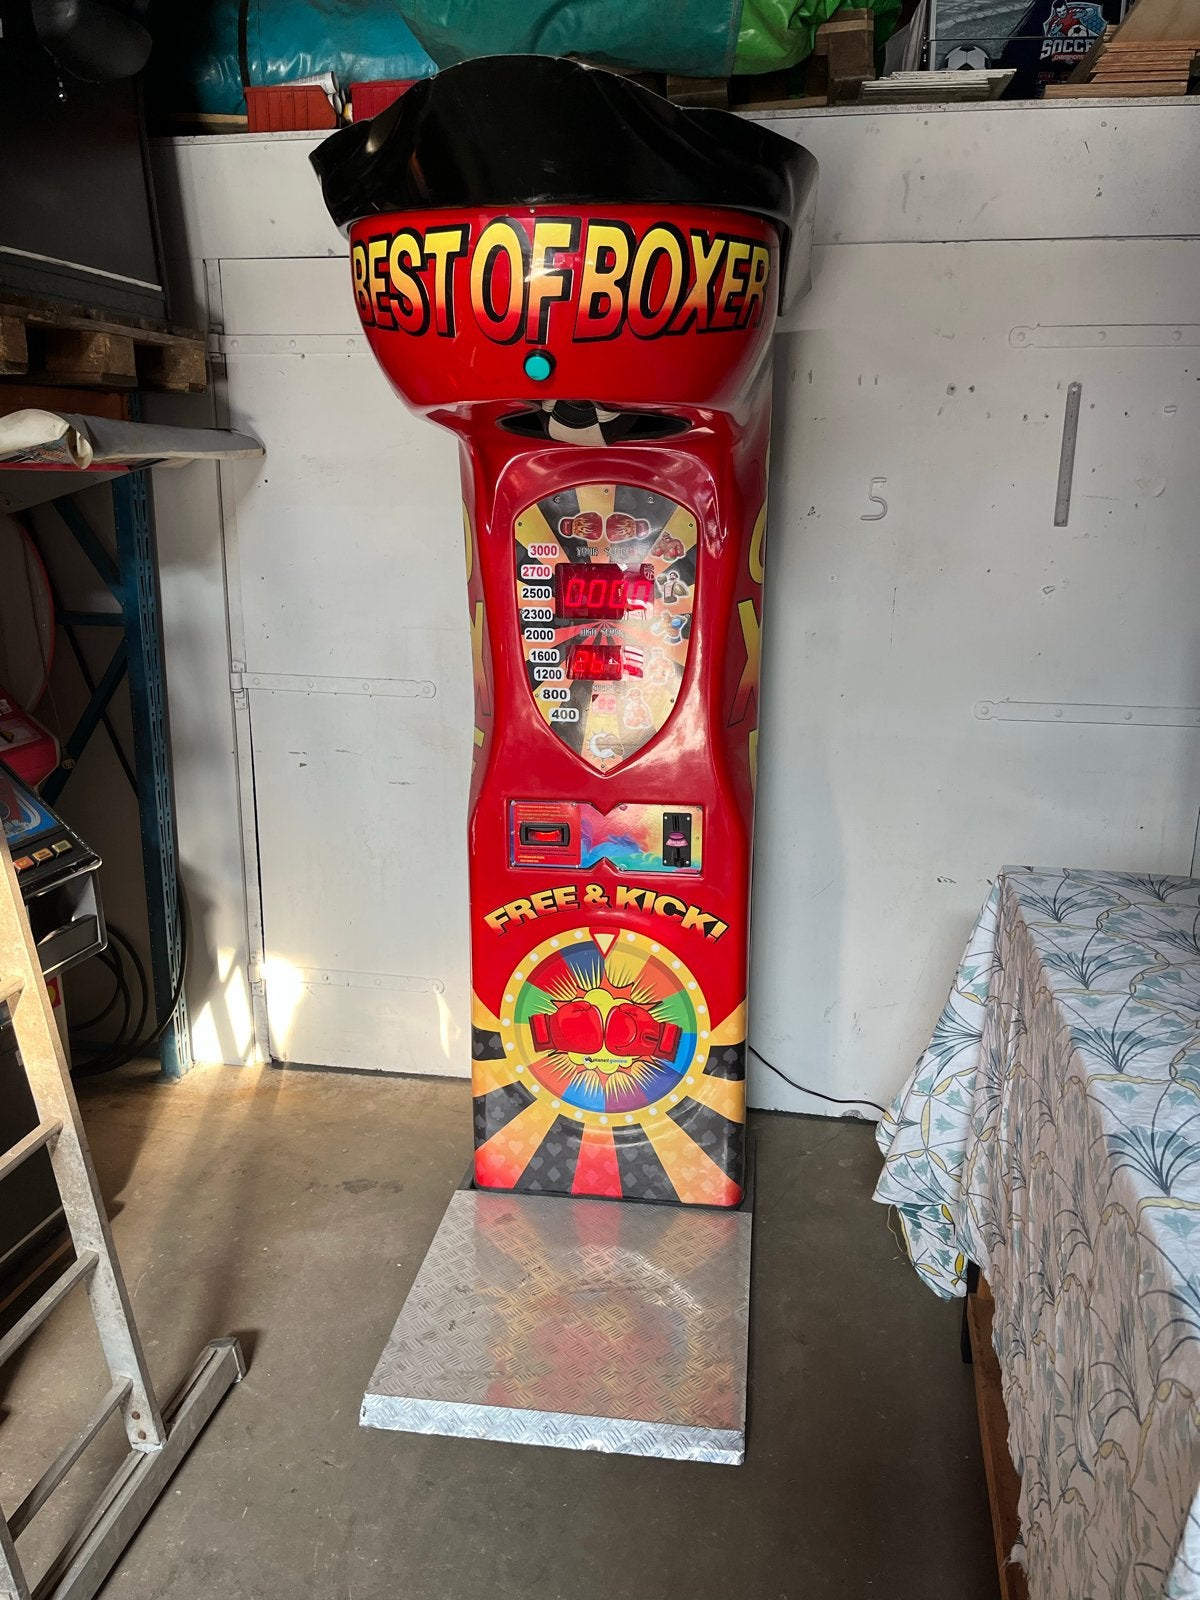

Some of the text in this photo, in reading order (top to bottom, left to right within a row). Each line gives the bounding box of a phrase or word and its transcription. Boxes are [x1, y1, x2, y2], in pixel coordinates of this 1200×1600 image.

[1040, 38, 1095, 60] SOCCE
[351, 216, 771, 345] BEST OF BOXER
[860, 477, 888, 521] 5
[530, 545, 558, 556] 3000
[522, 566, 551, 577] 2700
[522, 588, 551, 599] 2500
[523, 609, 552, 620] 2300
[525, 629, 554, 640] 2000
[530, 651, 557, 662] 1600
[535, 669, 562, 680] 1200
[542, 689, 567, 700] 800
[551, 709, 577, 720] 400
[483, 883, 730, 944] FREE & KICK!
